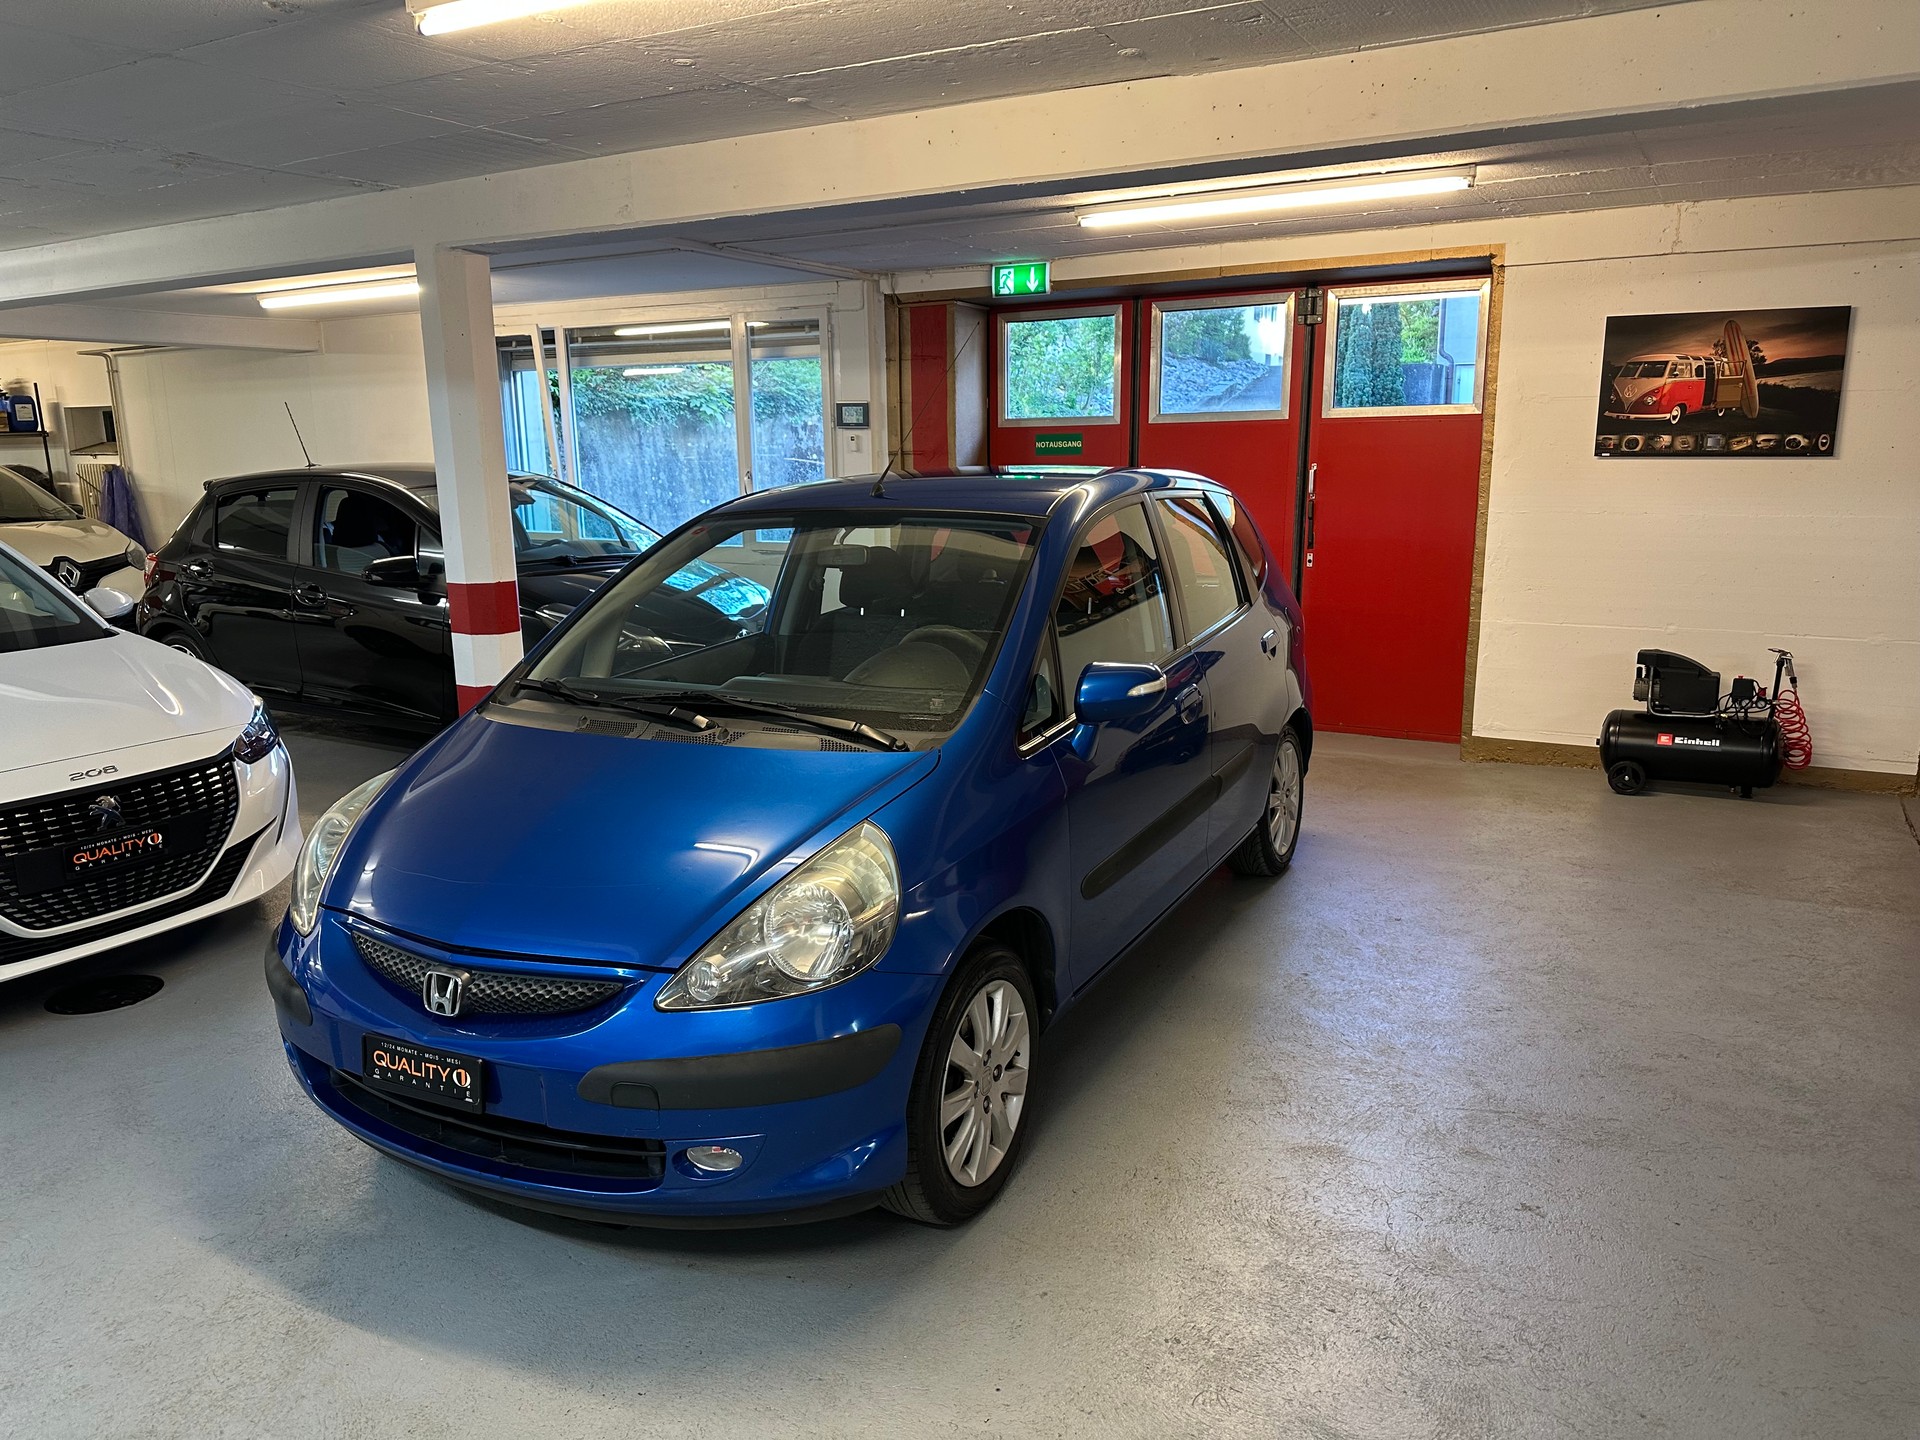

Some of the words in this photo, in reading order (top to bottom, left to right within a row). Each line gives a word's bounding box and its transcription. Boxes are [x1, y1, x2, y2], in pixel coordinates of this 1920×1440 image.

[1035, 440, 1082, 448] NOTAUSGANG
[1674, 736, 1720, 747] Einhell
[69, 765, 119, 782] 208
[381, 1042, 395, 1050] 12/24
[396, 1046, 418, 1056] MONATE
[424, 1053, 439, 1061] MOIS
[446, 1057, 461, 1065] MESI
[374, 1068, 471, 1098] GARANTIE
